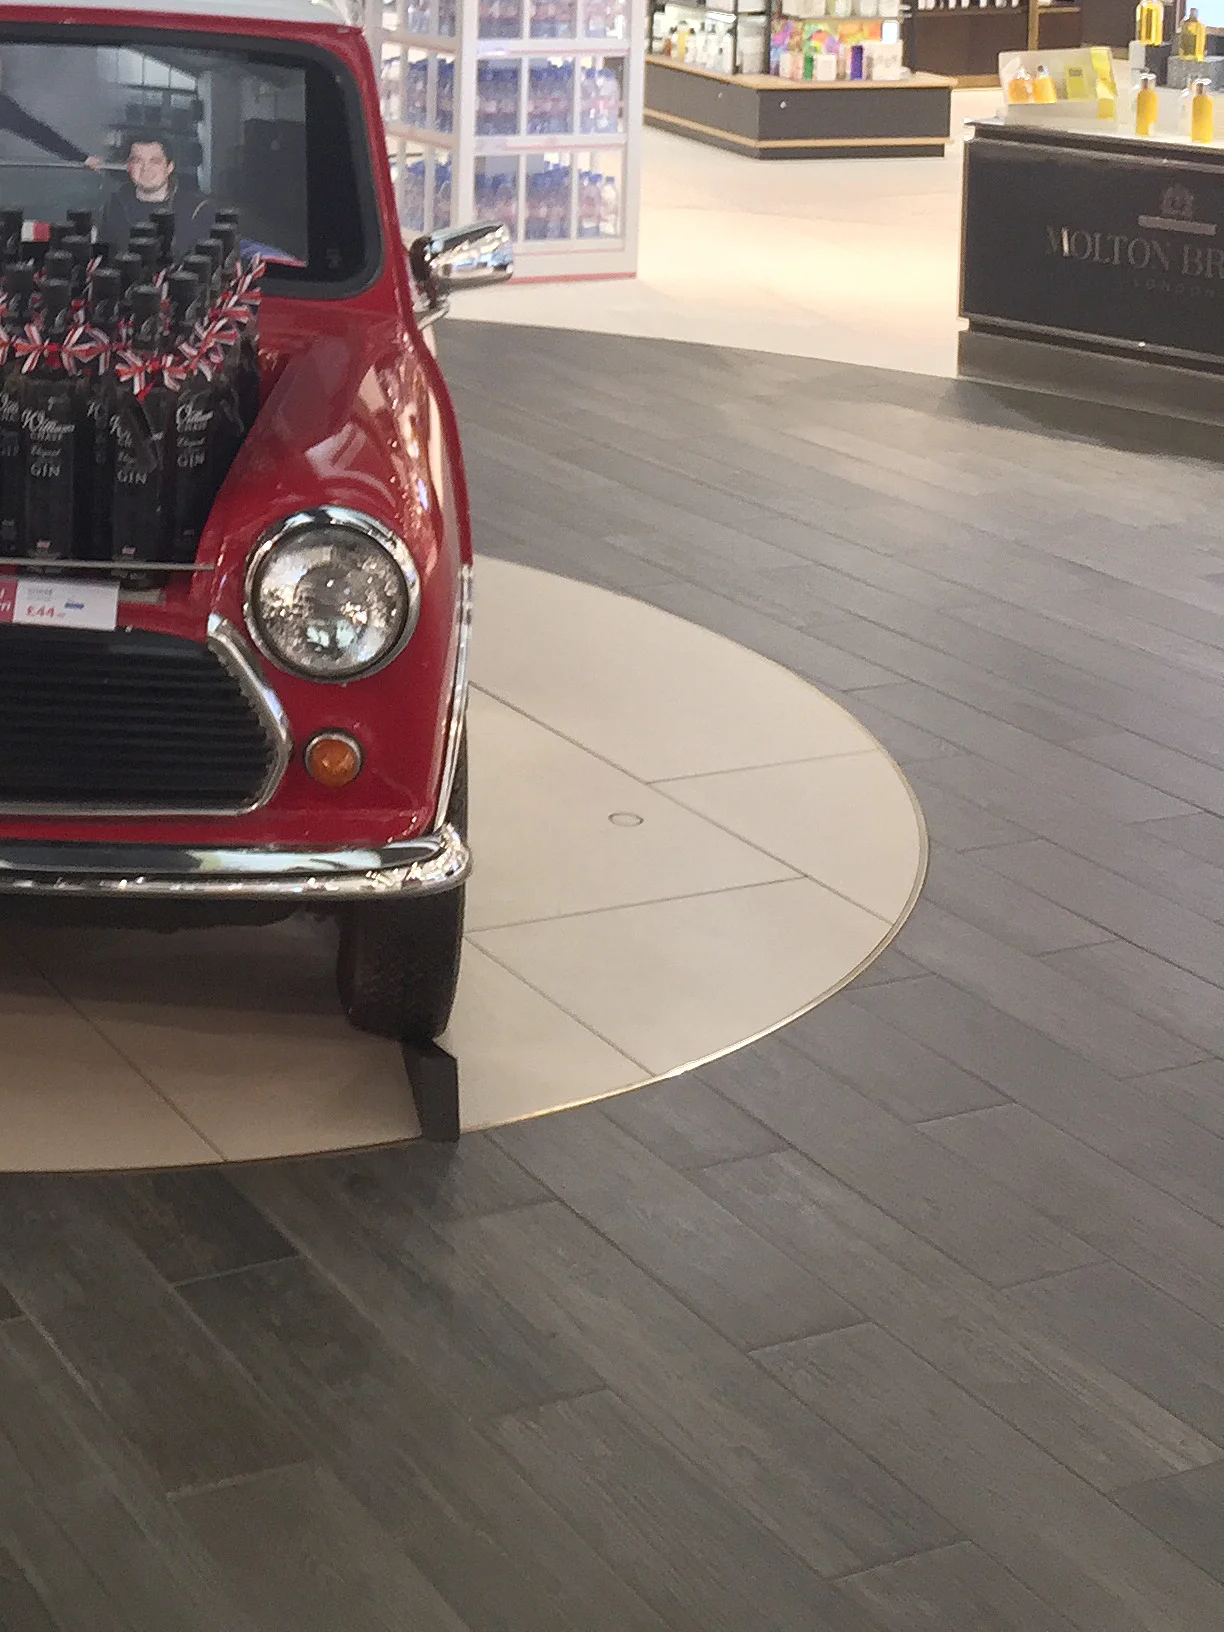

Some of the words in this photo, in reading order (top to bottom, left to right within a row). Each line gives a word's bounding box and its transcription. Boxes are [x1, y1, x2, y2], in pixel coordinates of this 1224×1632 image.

[1044, 225, 1170, 271] MOLTON
[30, 463, 61, 478] GIN
[117, 469, 147, 485] GIN
